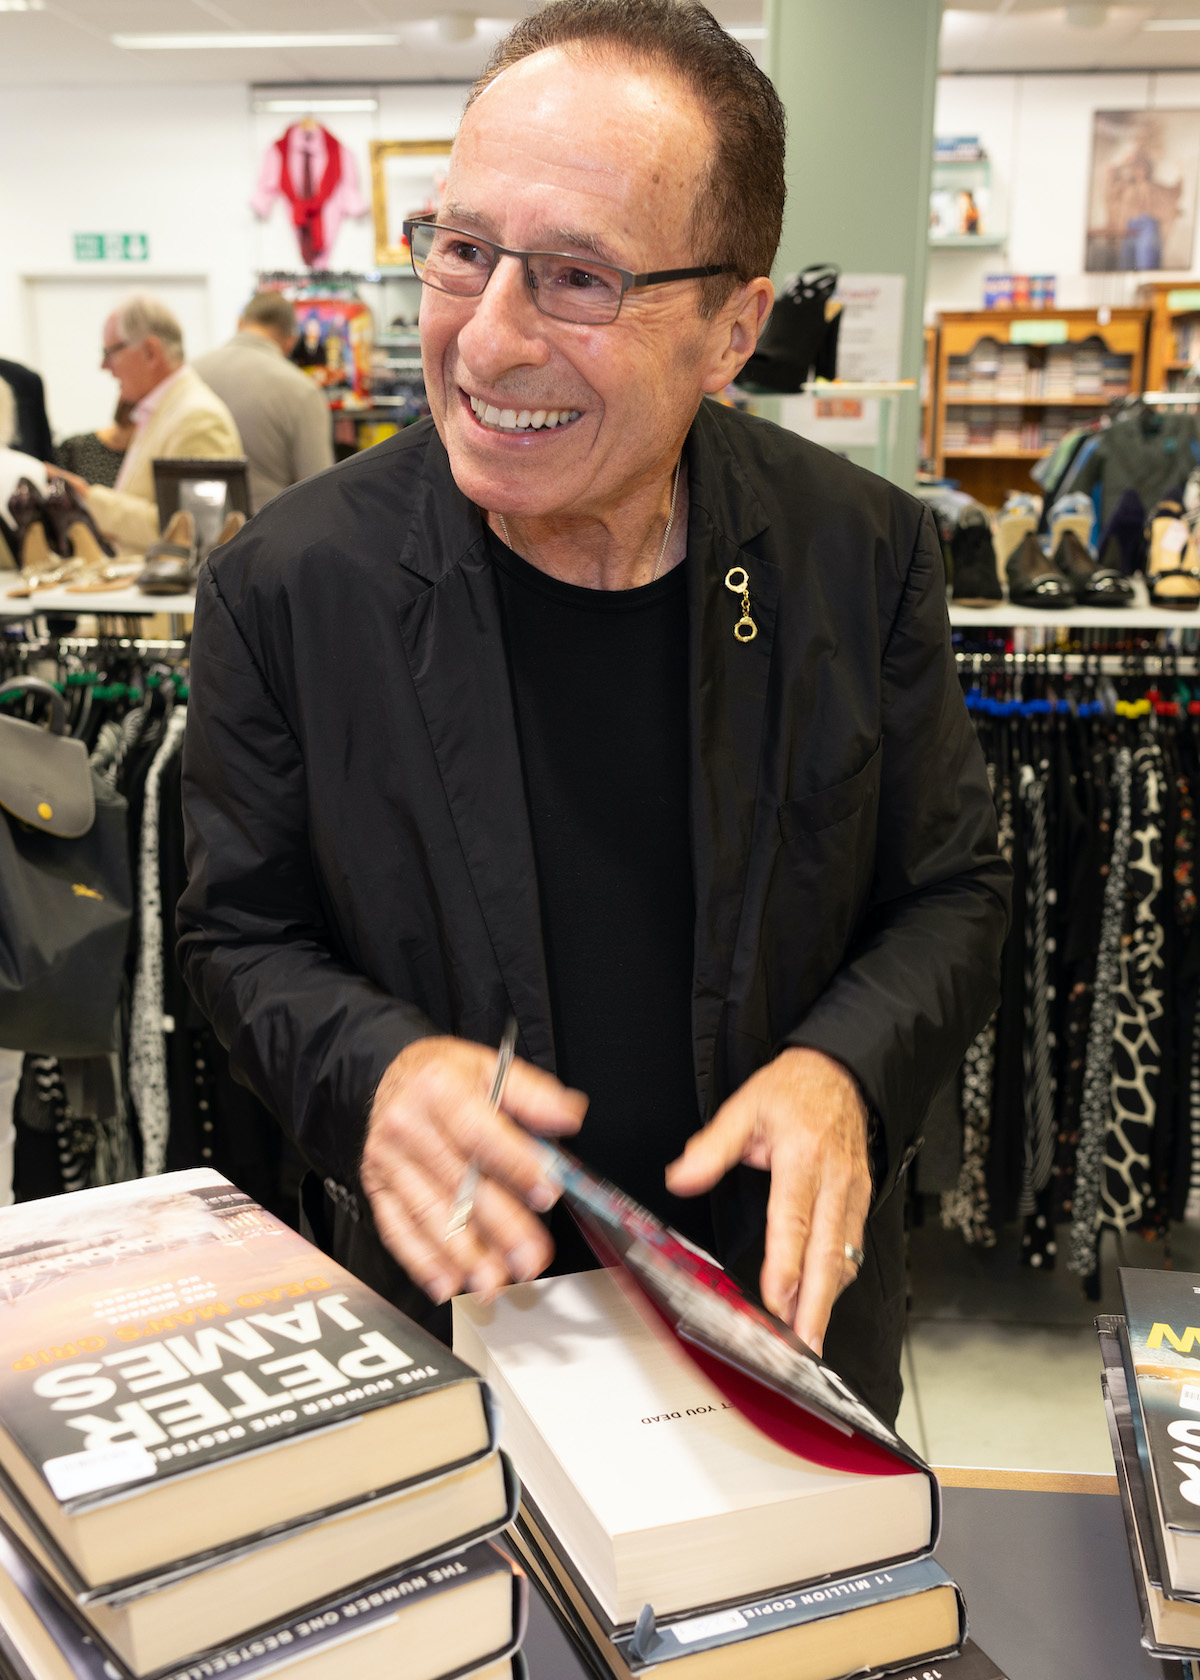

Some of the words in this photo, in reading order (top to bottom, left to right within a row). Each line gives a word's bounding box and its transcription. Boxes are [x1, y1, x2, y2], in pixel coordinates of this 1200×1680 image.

[236, 1276, 331, 1308] DEAD
[114, 1301, 231, 1340] MAN'S
[11, 1335, 107, 1372] GRIP
[33, 1293, 364, 1411] JAMES
[395, 1365, 439, 1385] THE
[65, 1331, 415, 1452] PETER
[301, 1377, 394, 1415] NUMBER
[249, 1408, 298, 1432] ONE
[641, 1411, 682, 1425] DEAD
[686, 1405, 717, 1416] YOU
[428, 1561, 468, 1584] THE
[874, 1573, 893, 1586] 11
[341, 1574, 428, 1617] NUMBER
[802, 1578, 872, 1606] MILLION
[295, 1610, 340, 1637] ONE
[164, 1629, 294, 1680] BESTSELLE
